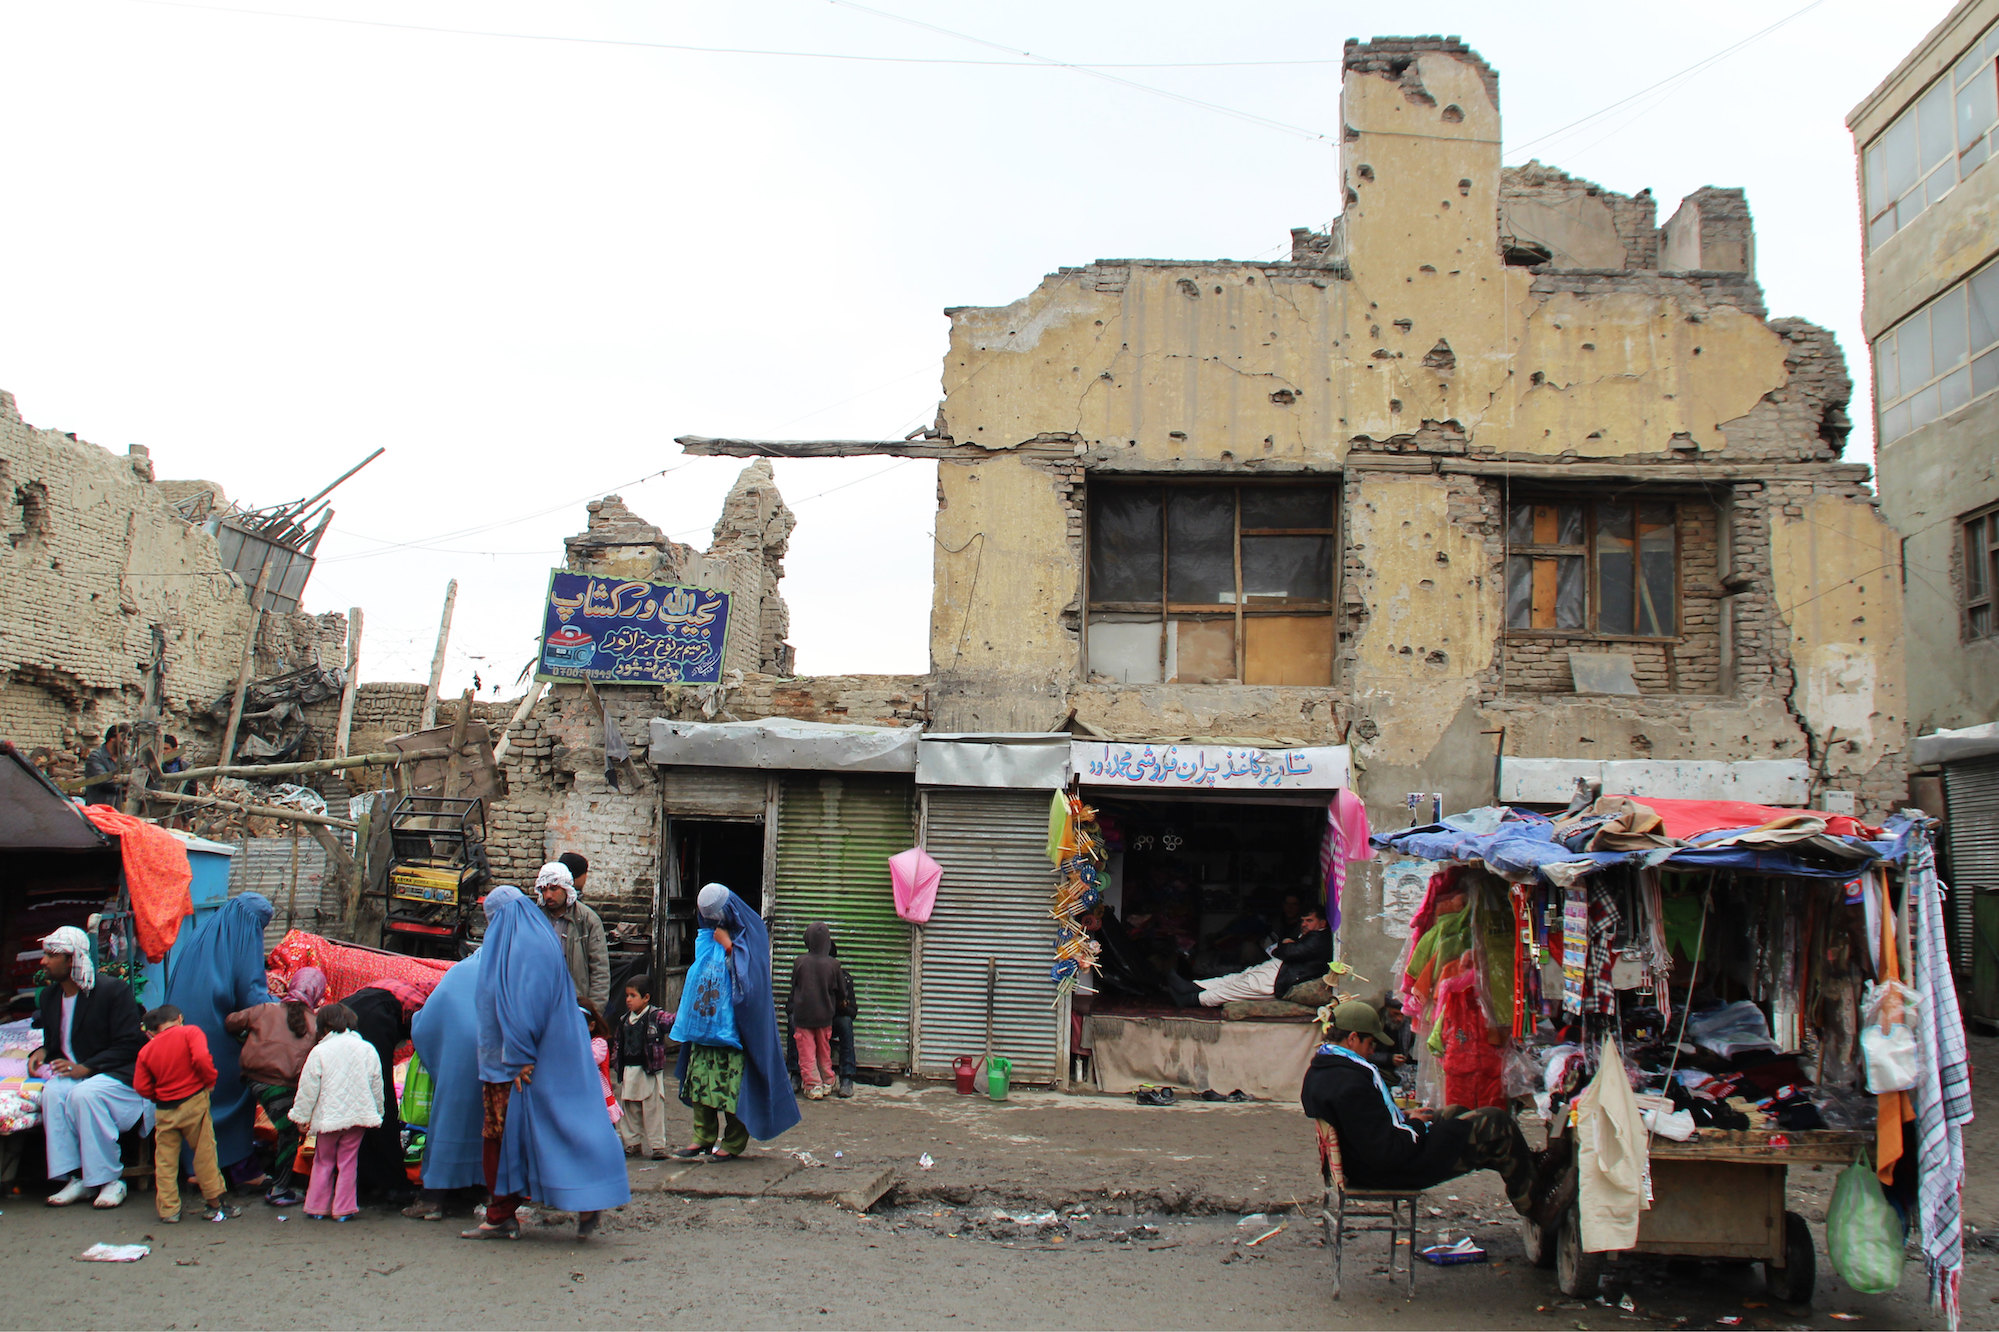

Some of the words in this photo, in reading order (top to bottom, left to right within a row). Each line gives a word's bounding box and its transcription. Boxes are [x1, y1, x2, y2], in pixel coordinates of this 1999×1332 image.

[551, 580, 658, 623] ورکشاپ
[654, 637, 676, 659] نوع
[681, 643, 708, 662] ترمیم
